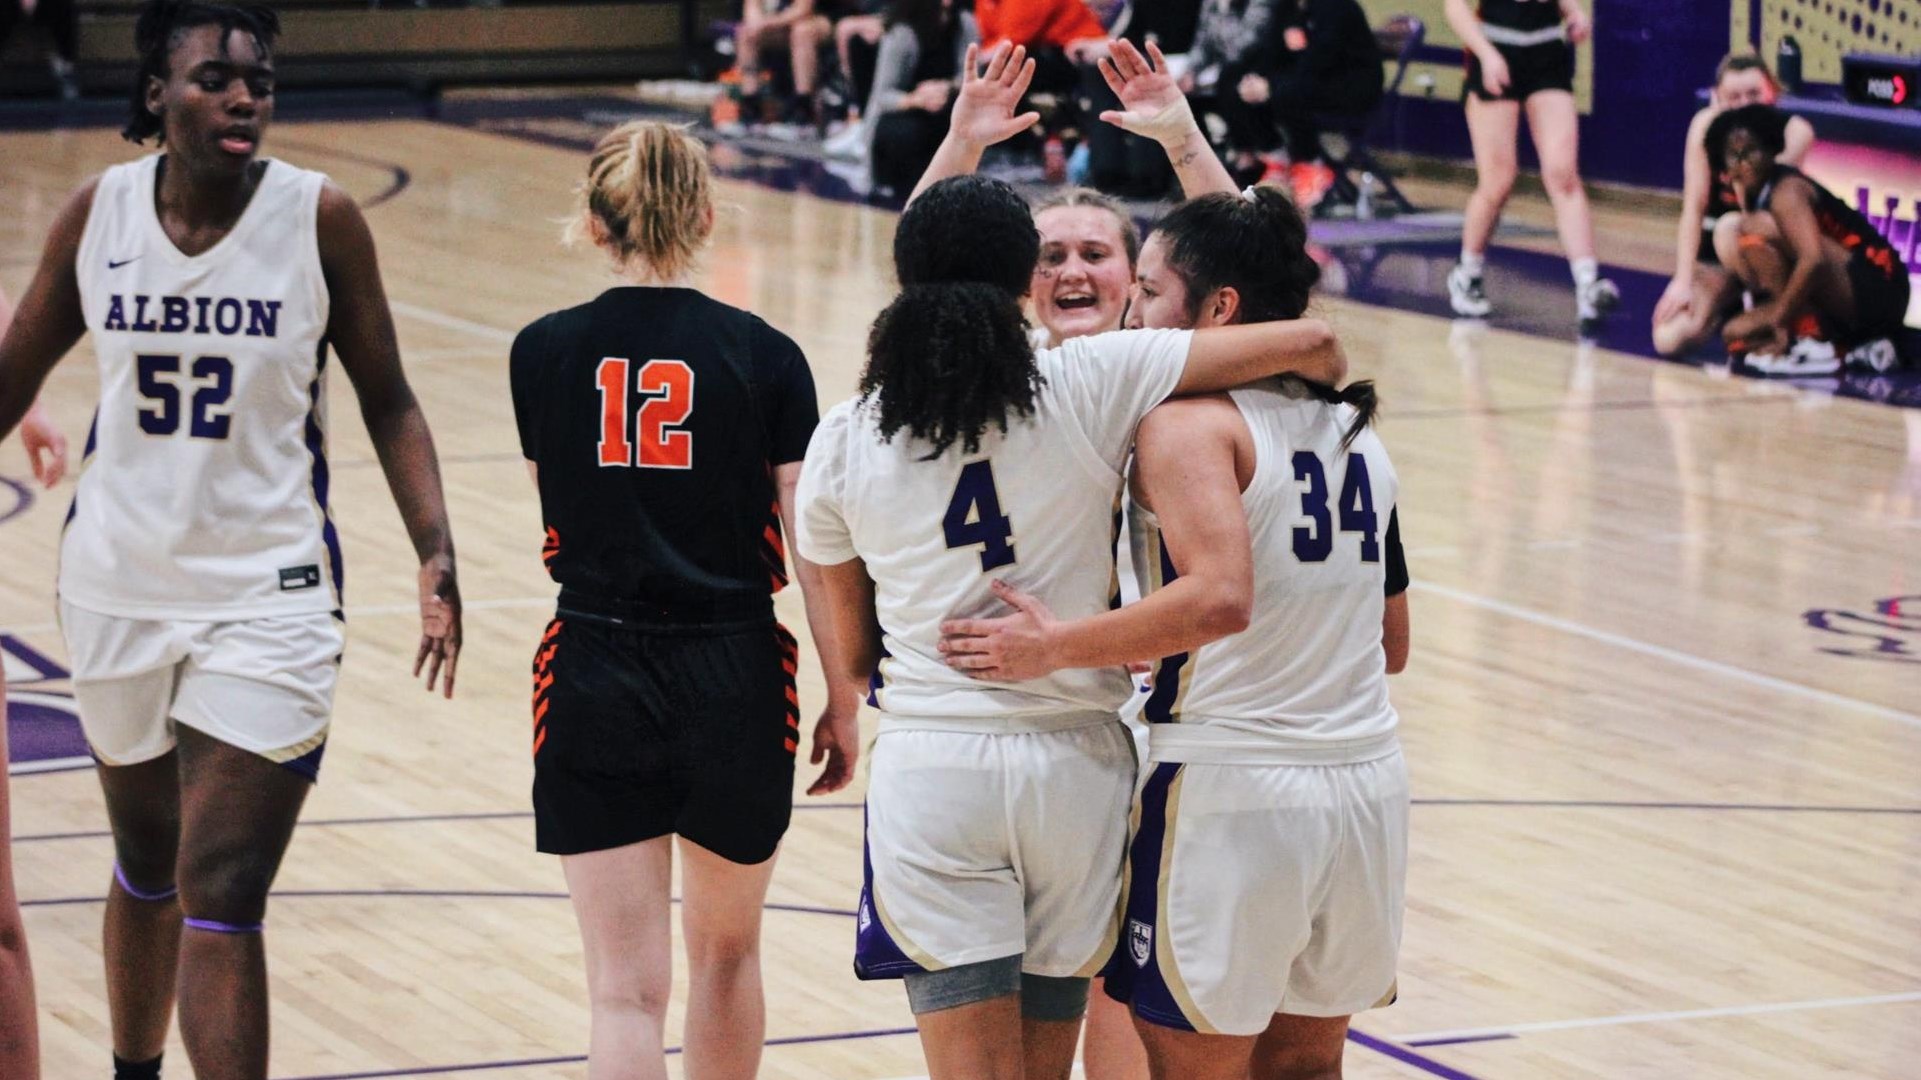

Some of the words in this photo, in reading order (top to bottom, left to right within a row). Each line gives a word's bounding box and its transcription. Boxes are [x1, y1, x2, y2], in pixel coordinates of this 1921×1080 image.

[105, 294, 282, 338] ALBION
[136, 352, 235, 441] 52
[595, 356, 695, 470] 12
[941, 458, 1018, 573] 4
[1290, 450, 1381, 565] 34
